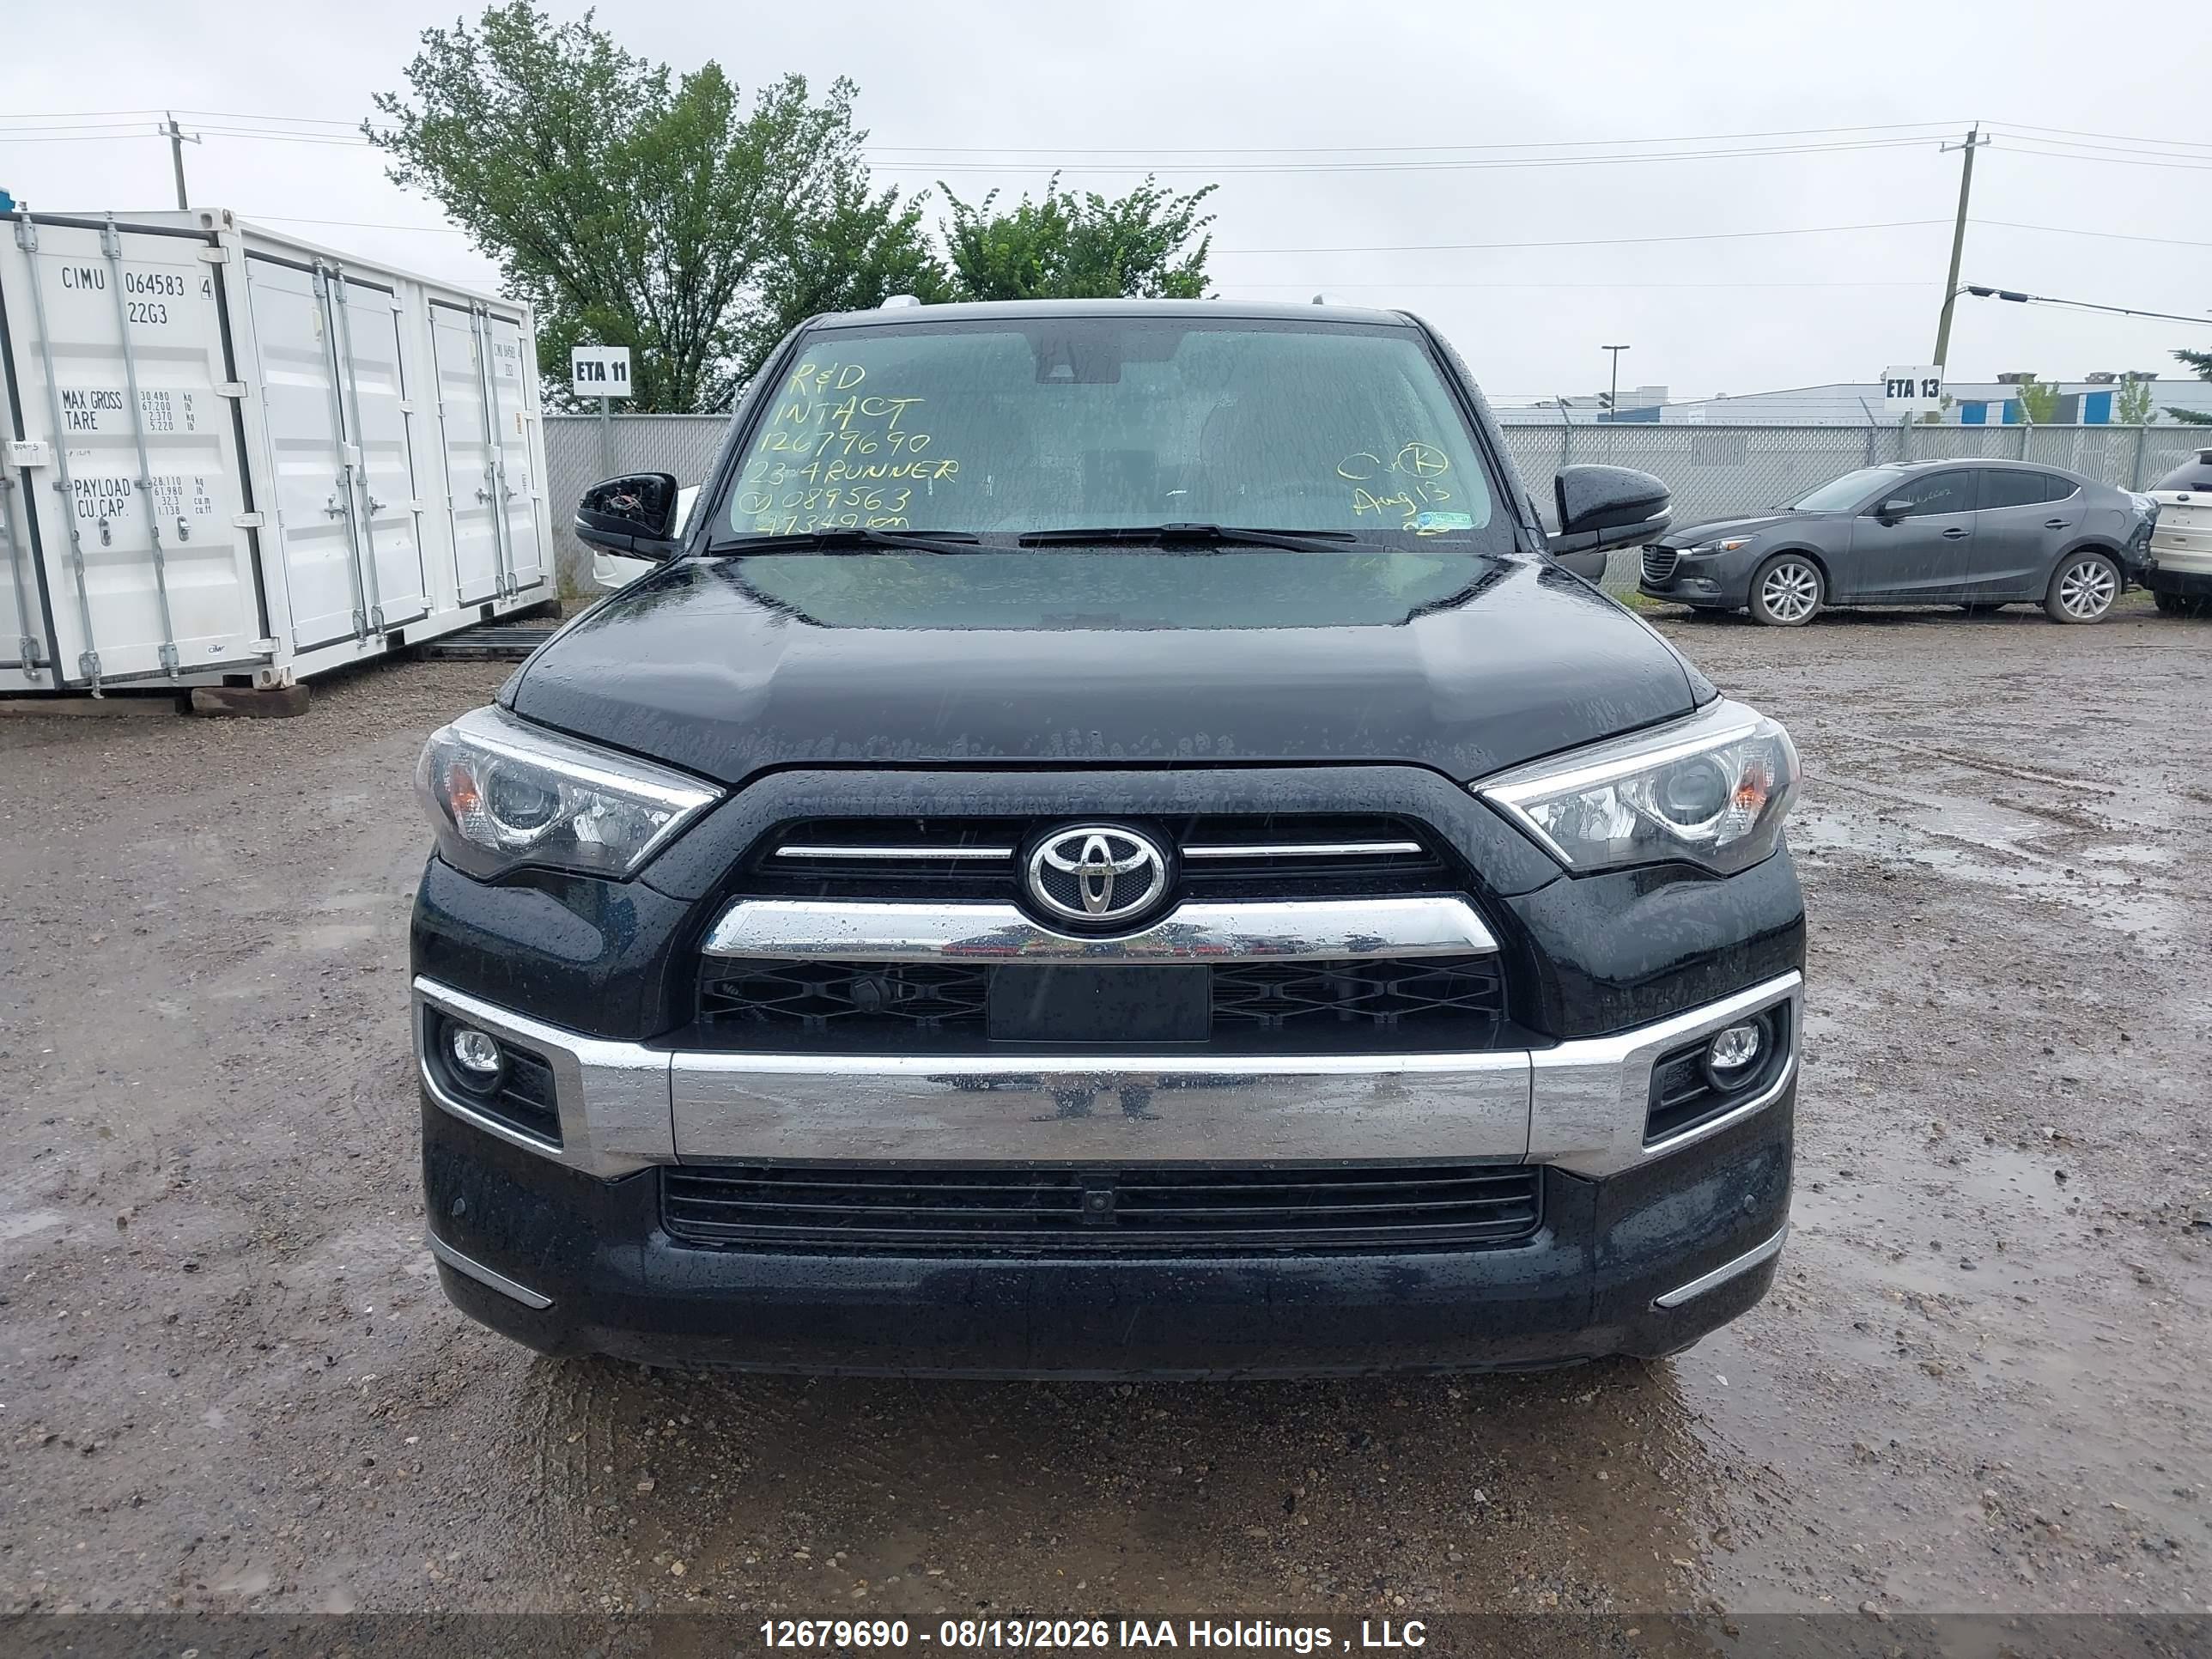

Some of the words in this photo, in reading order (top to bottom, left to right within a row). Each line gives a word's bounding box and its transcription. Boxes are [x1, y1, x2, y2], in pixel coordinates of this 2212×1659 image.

[62, 267, 105, 290] CIMU
[125, 272, 185, 296] 064583
[202, 278, 211, 298] 4
[128, 302, 167, 324] 22G3
[576, 361, 606, 381] ETA
[611, 361, 627, 381] 11
[141, 392, 170, 401] 30.480
[183, 392, 192, 403] kg
[1886, 379, 1915, 398] ETA
[1921, 378, 1940, 398] 13
[62, 390, 86, 410] MAX
[90, 391, 123, 410] GROSS
[142, 402, 171, 411] 67.200
[185, 402, 191, 411] lb
[65, 411, 98, 430] TARE
[149, 411, 172, 421] 2.370
[186, 412, 195, 423] kg
[774, 395, 926, 430] INTACT
[150, 422, 173, 431] 5.220
[187, 422, 194, 431] lb
[760, 430, 931, 457] 12679690
[74, 478, 130, 498] PAYLOAD
[153, 477, 181, 486] 28.110
[195, 477, 204, 487] kg
[155, 487, 183, 495] 61.980
[197, 487, 204, 495] lb
[78, 499, 129, 518] CU.CAP.
[161, 496, 179, 506] 32.3
[158, 507, 180, 516] 1.138
